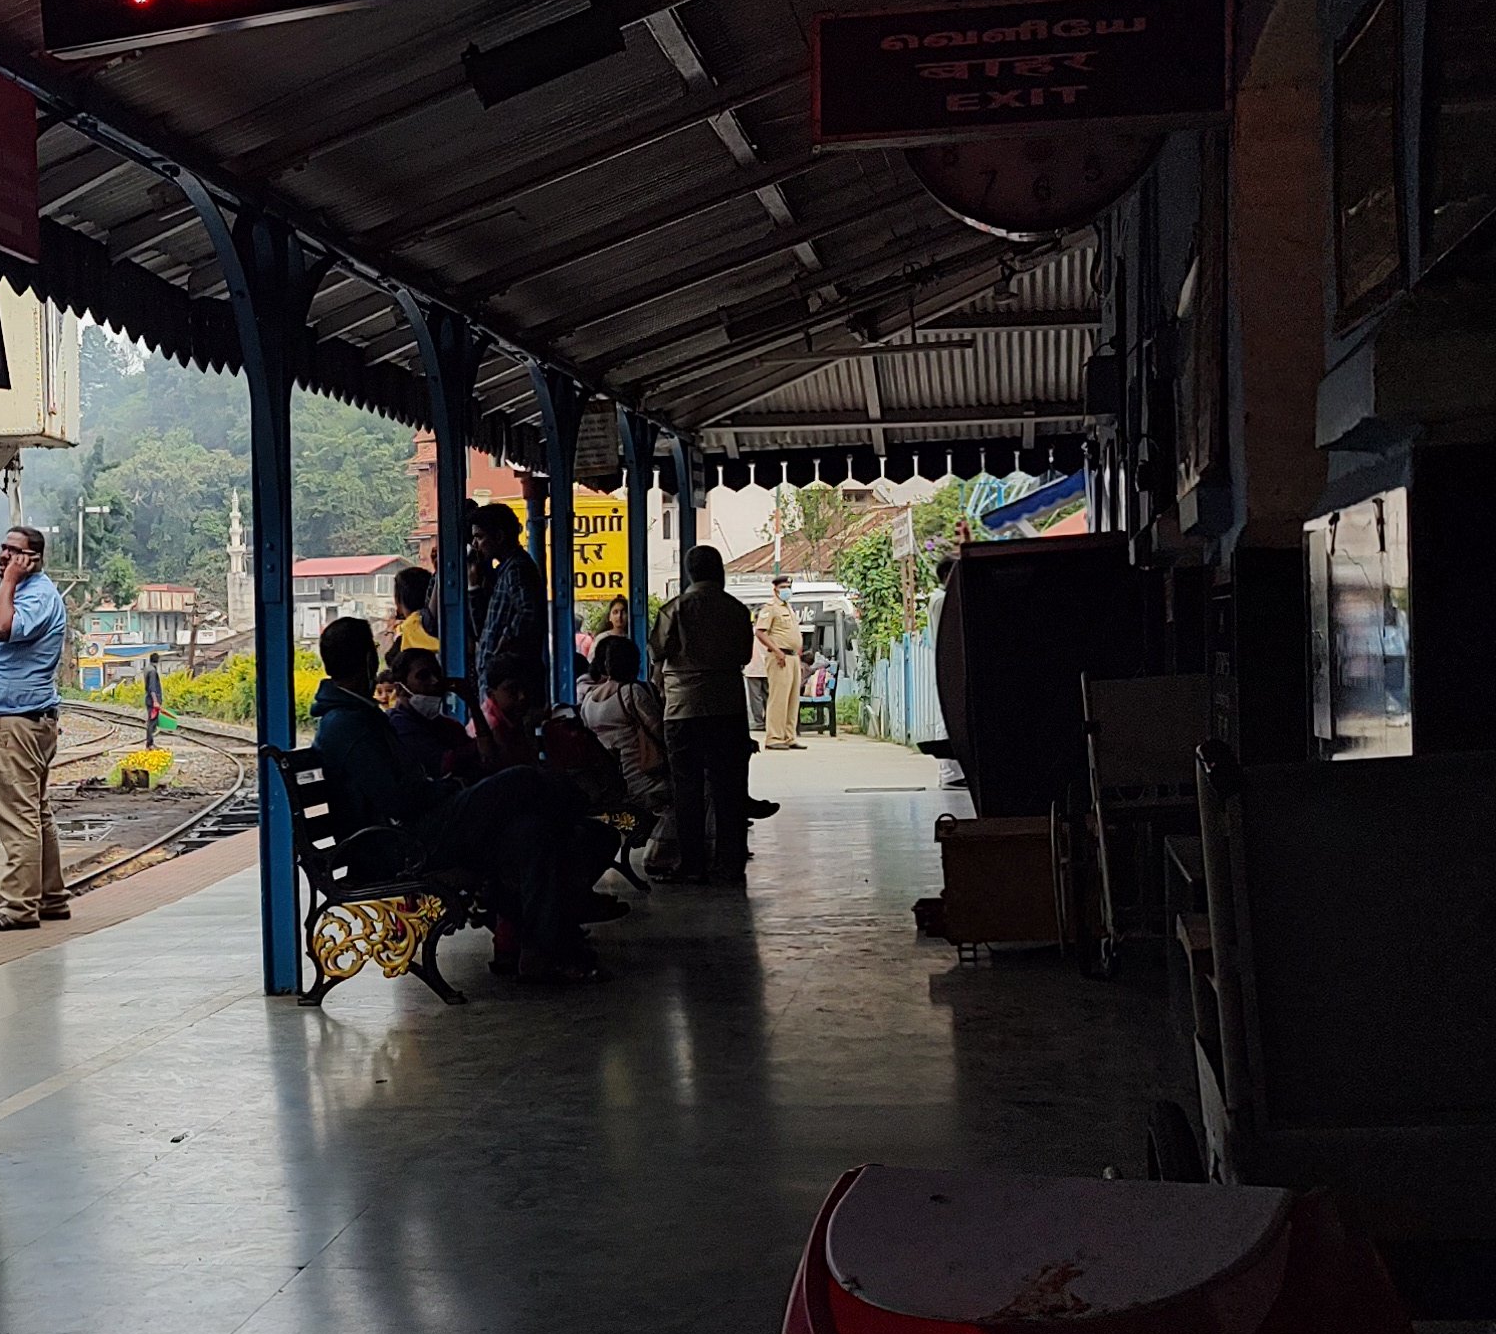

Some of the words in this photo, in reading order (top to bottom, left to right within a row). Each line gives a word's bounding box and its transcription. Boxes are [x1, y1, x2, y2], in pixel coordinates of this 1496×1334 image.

[880, 16, 1149, 52] வெளியே
[914, 51, 1099, 81] बाहर
[945, 84, 1089, 113] EXIT
[574, 571, 624, 589] OOR
